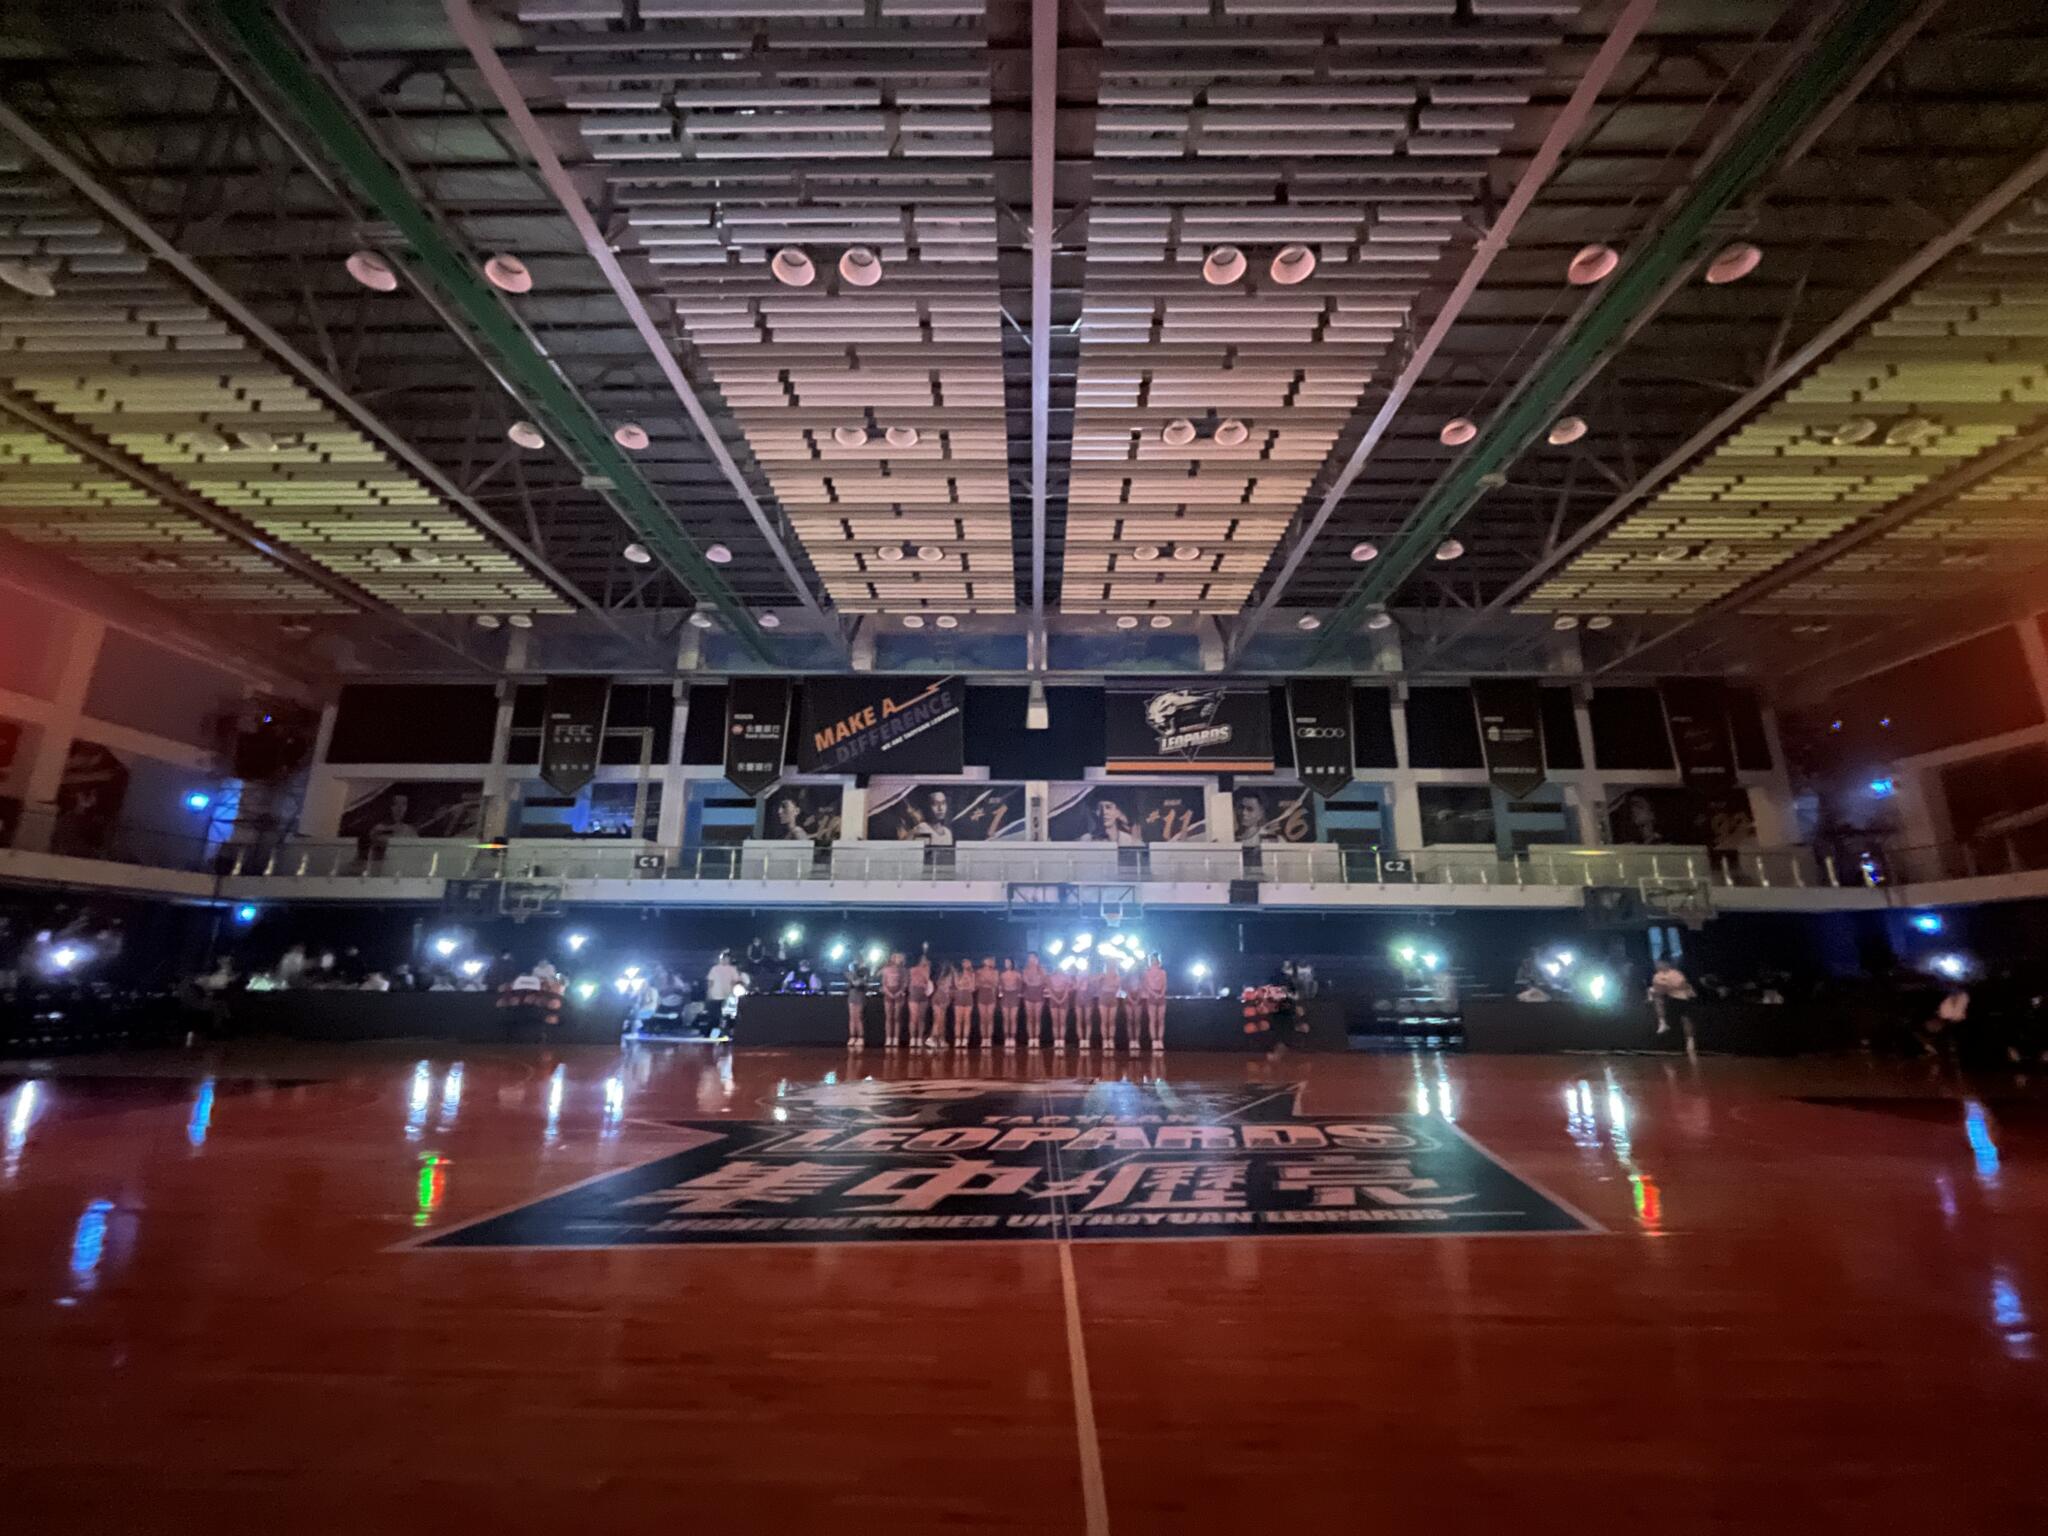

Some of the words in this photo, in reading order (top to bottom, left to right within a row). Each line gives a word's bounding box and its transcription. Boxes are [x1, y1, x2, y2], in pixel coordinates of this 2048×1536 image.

[814, 706, 877, 752] MAKE
[836, 691, 953, 763] DIFFERENCE
[1161, 725, 1231, 751] LEOPARDS
[639, 856, 659, 867] C1
[1384, 861, 1406, 872] C2
[762, 1124, 1418, 1153] LEOPARDS
[1067, 1211, 1253, 1226] TAOYUAN
[1264, 1209, 1447, 1223] LEOPARDS
